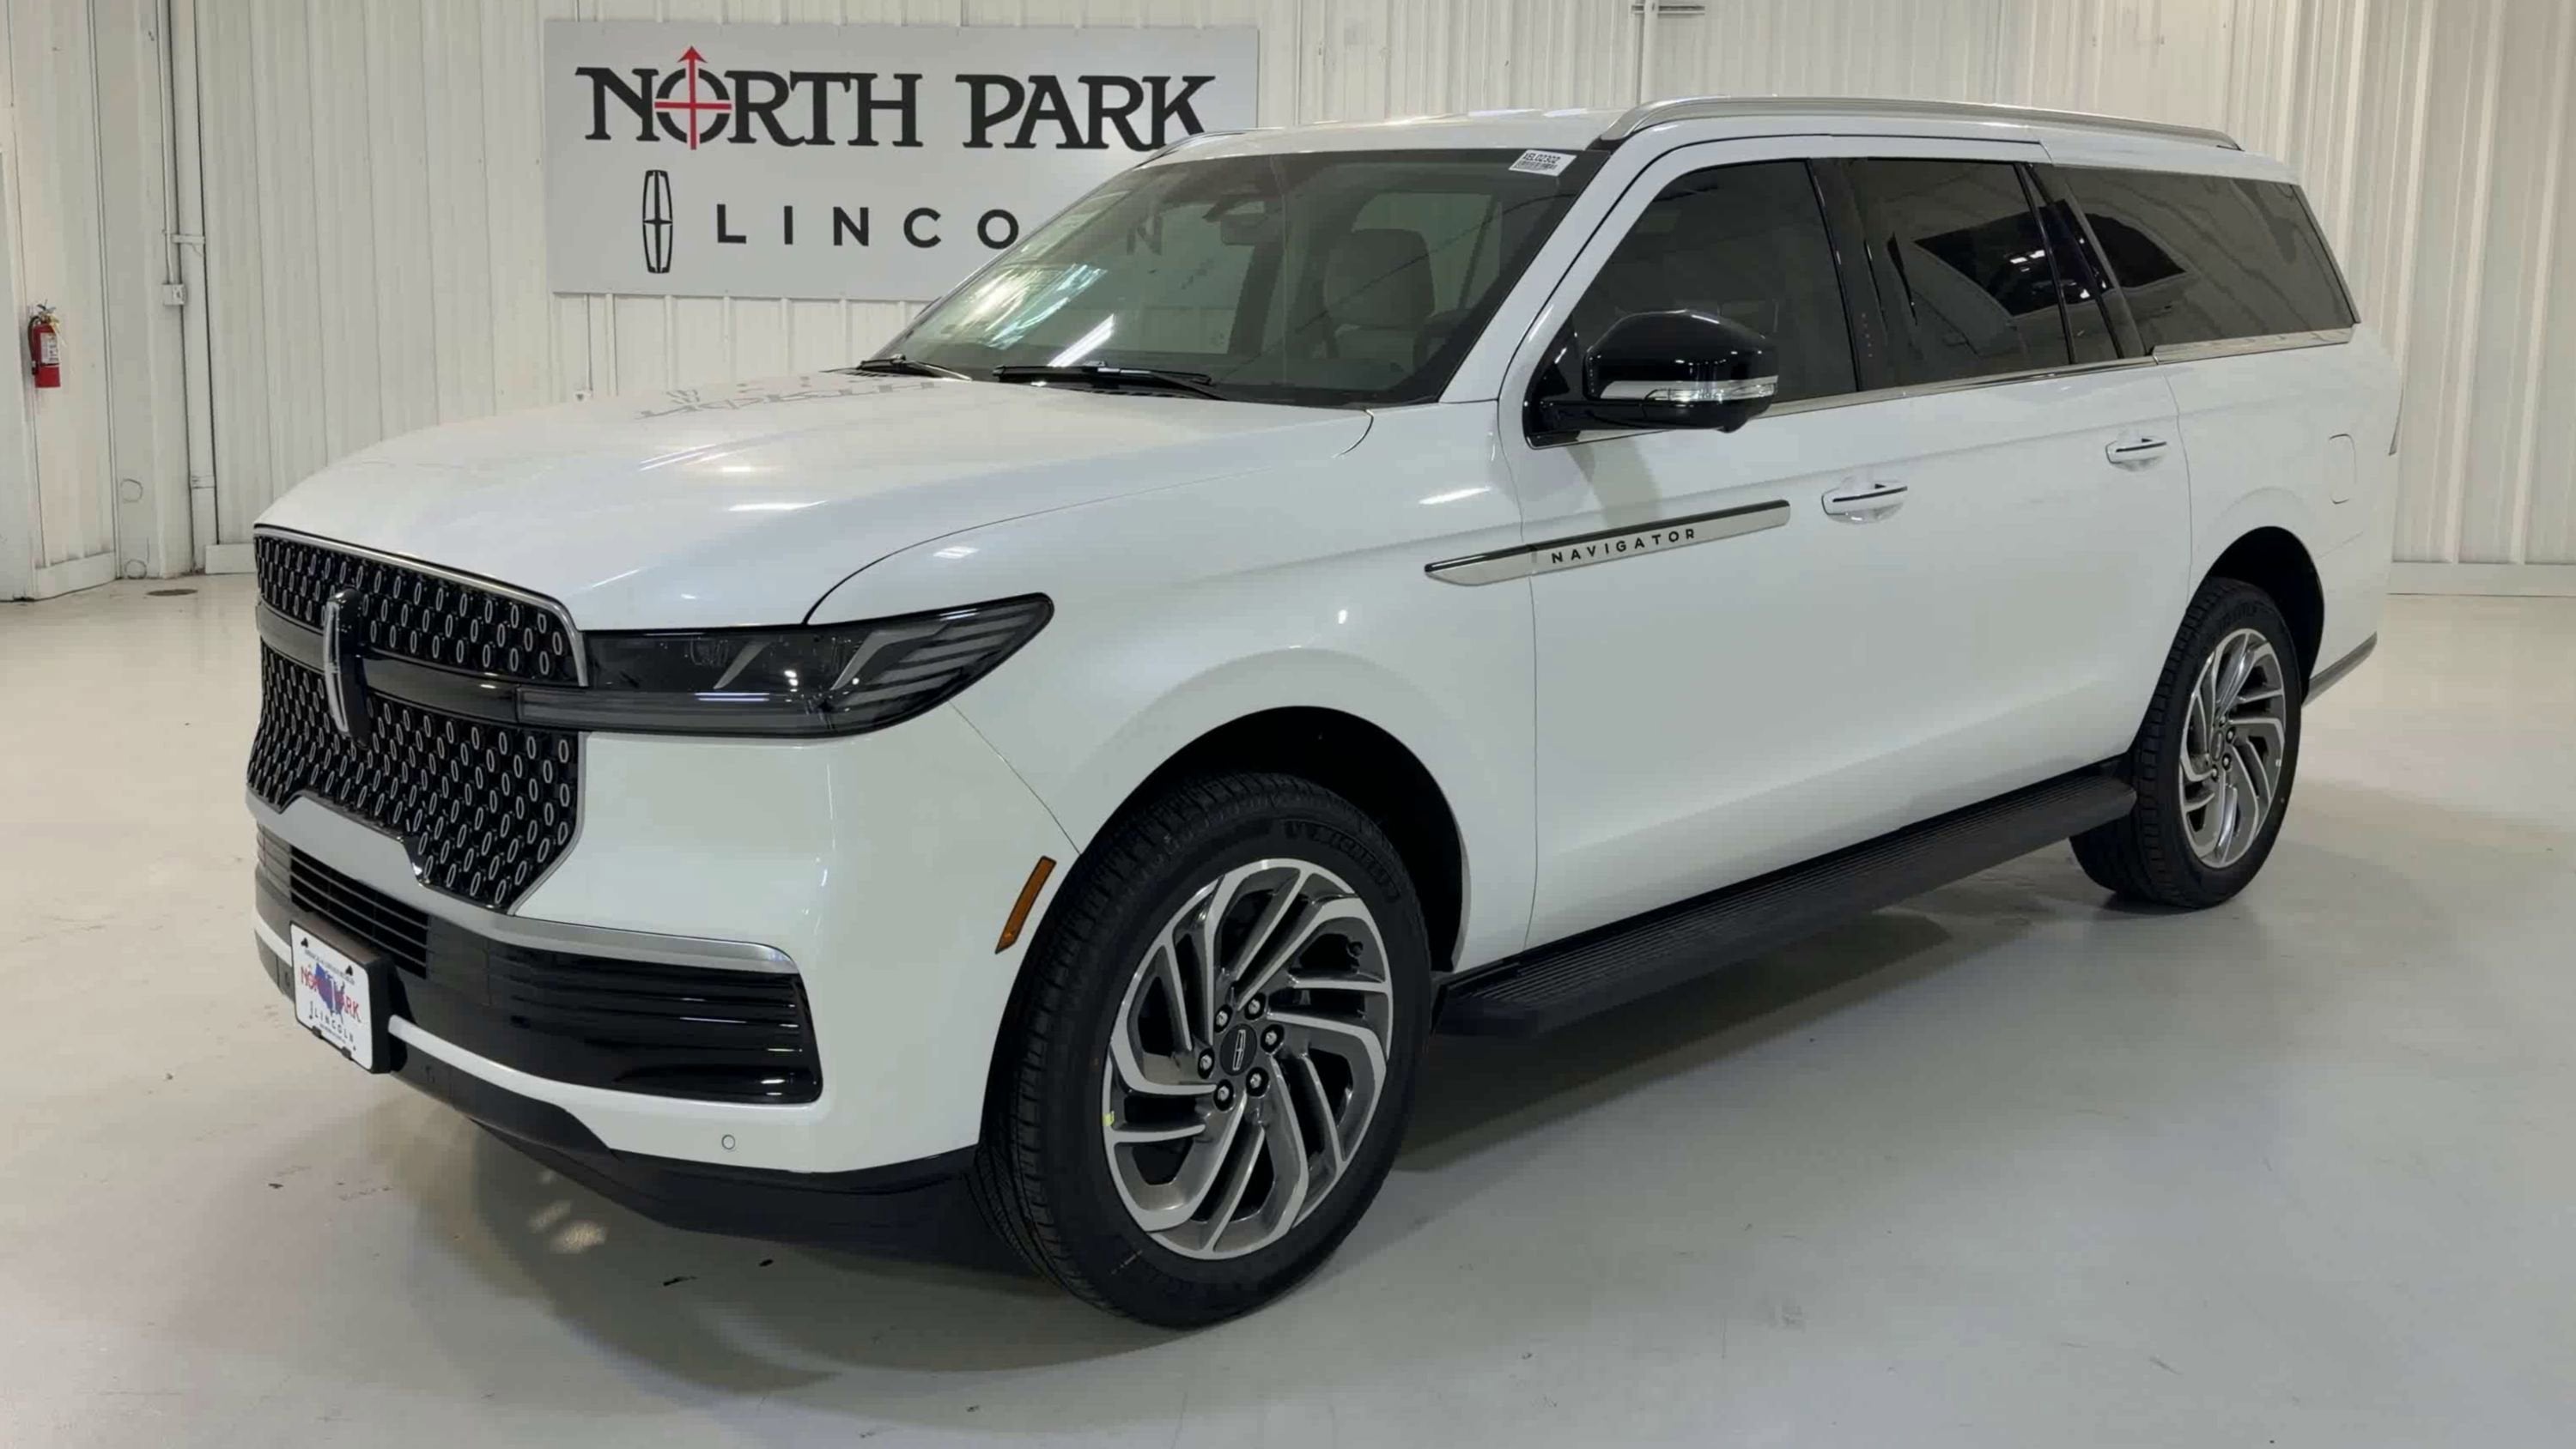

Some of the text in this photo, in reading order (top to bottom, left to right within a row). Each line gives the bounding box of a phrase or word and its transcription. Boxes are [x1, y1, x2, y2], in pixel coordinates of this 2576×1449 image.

[574, 66, 1216, 152] NORTH PARK
[716, 203, 1163, 256] LINCON
[1551, 528, 1695, 564] NAVIGATOR
